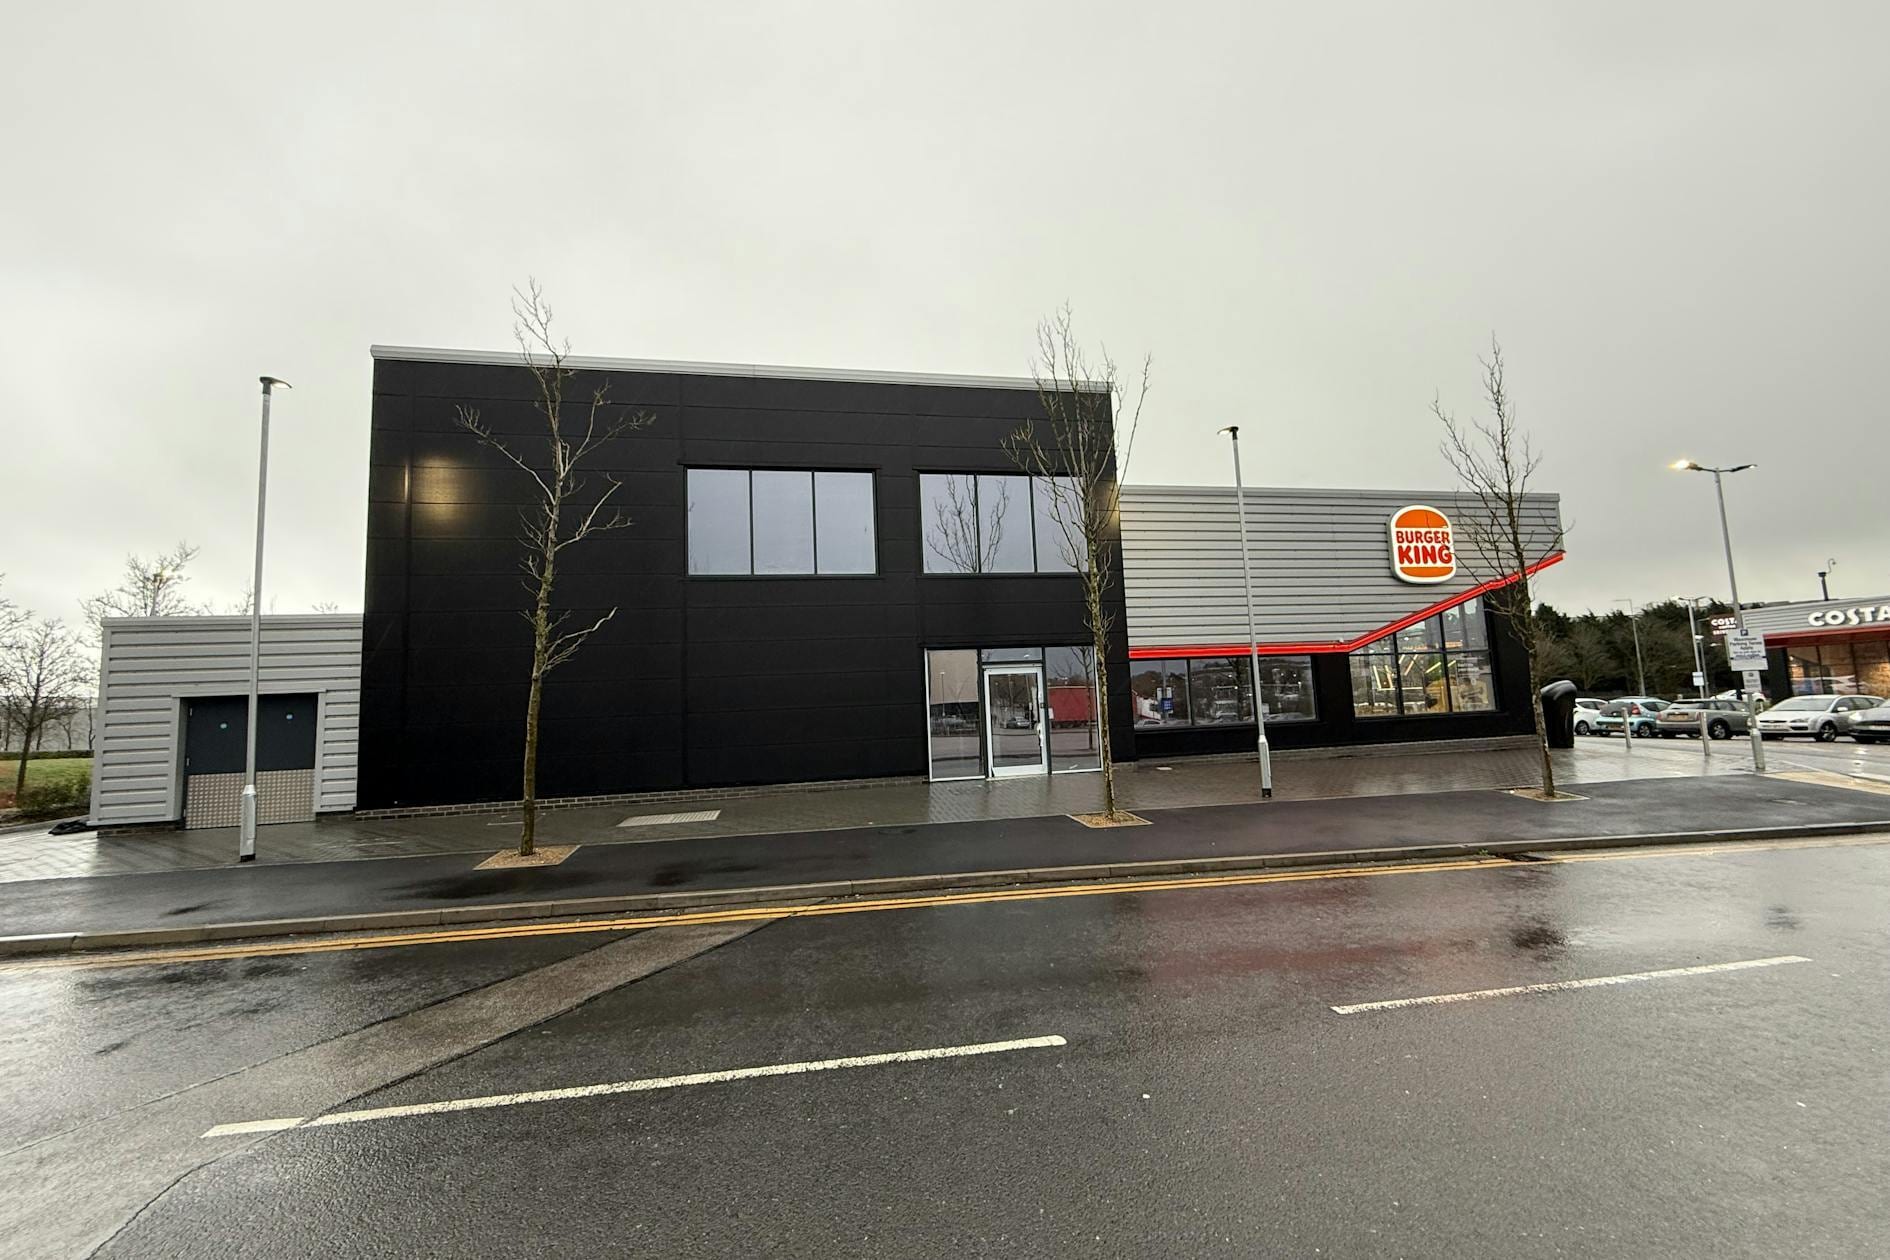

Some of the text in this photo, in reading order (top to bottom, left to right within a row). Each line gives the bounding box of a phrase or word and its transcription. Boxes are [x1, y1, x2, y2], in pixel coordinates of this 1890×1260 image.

[1396, 531, 1450, 543] BURGER
[1397, 545, 1452, 564] KING
[1808, 605, 1890, 627] COSTA
